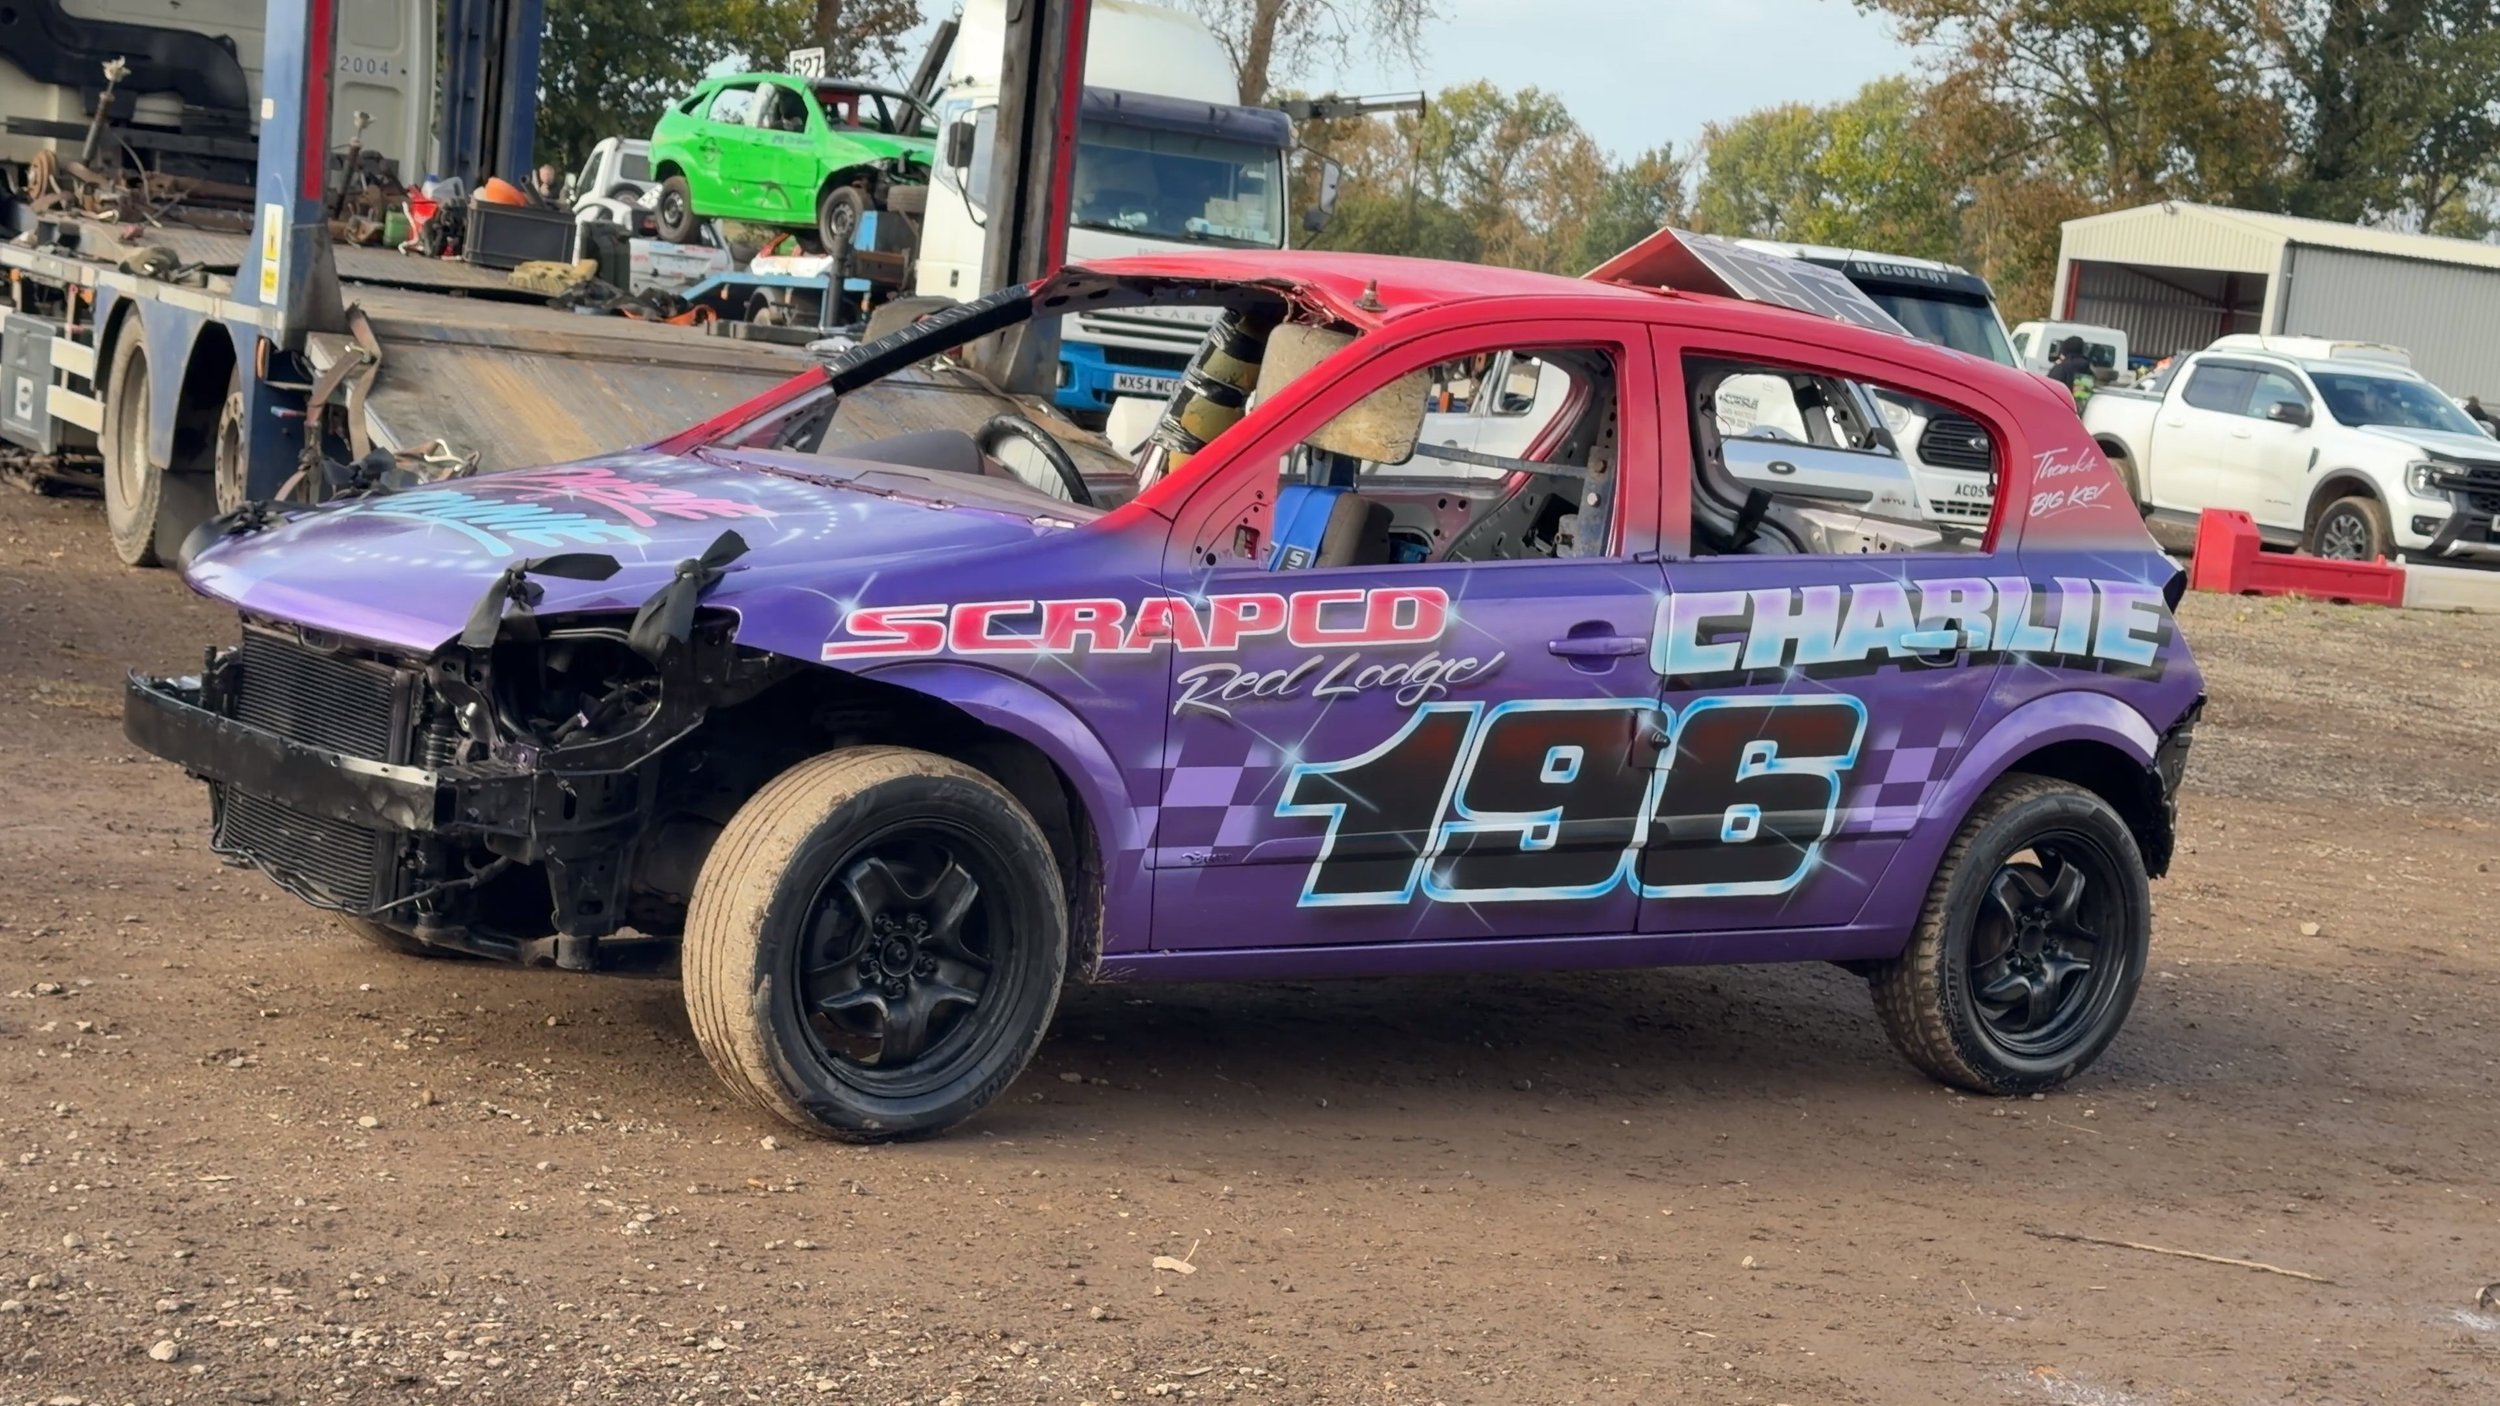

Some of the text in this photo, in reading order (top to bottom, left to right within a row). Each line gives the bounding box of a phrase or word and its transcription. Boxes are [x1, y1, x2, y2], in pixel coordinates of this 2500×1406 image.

[340, 55, 388, 75] 2004
[1855, 262, 1950, 284] RECOVERY
[1118, 375, 1152, 390] MX54
[2033, 447, 2098, 486] Thanks
[2029, 481, 2111, 517] BIG KEV
[821, 586, 1449, 660] SCRAPCO
[1650, 576, 2165, 675] CHARLIE
[1173, 651, 1505, 718] Red Lodge
[1274, 693, 1869, 909] 196
